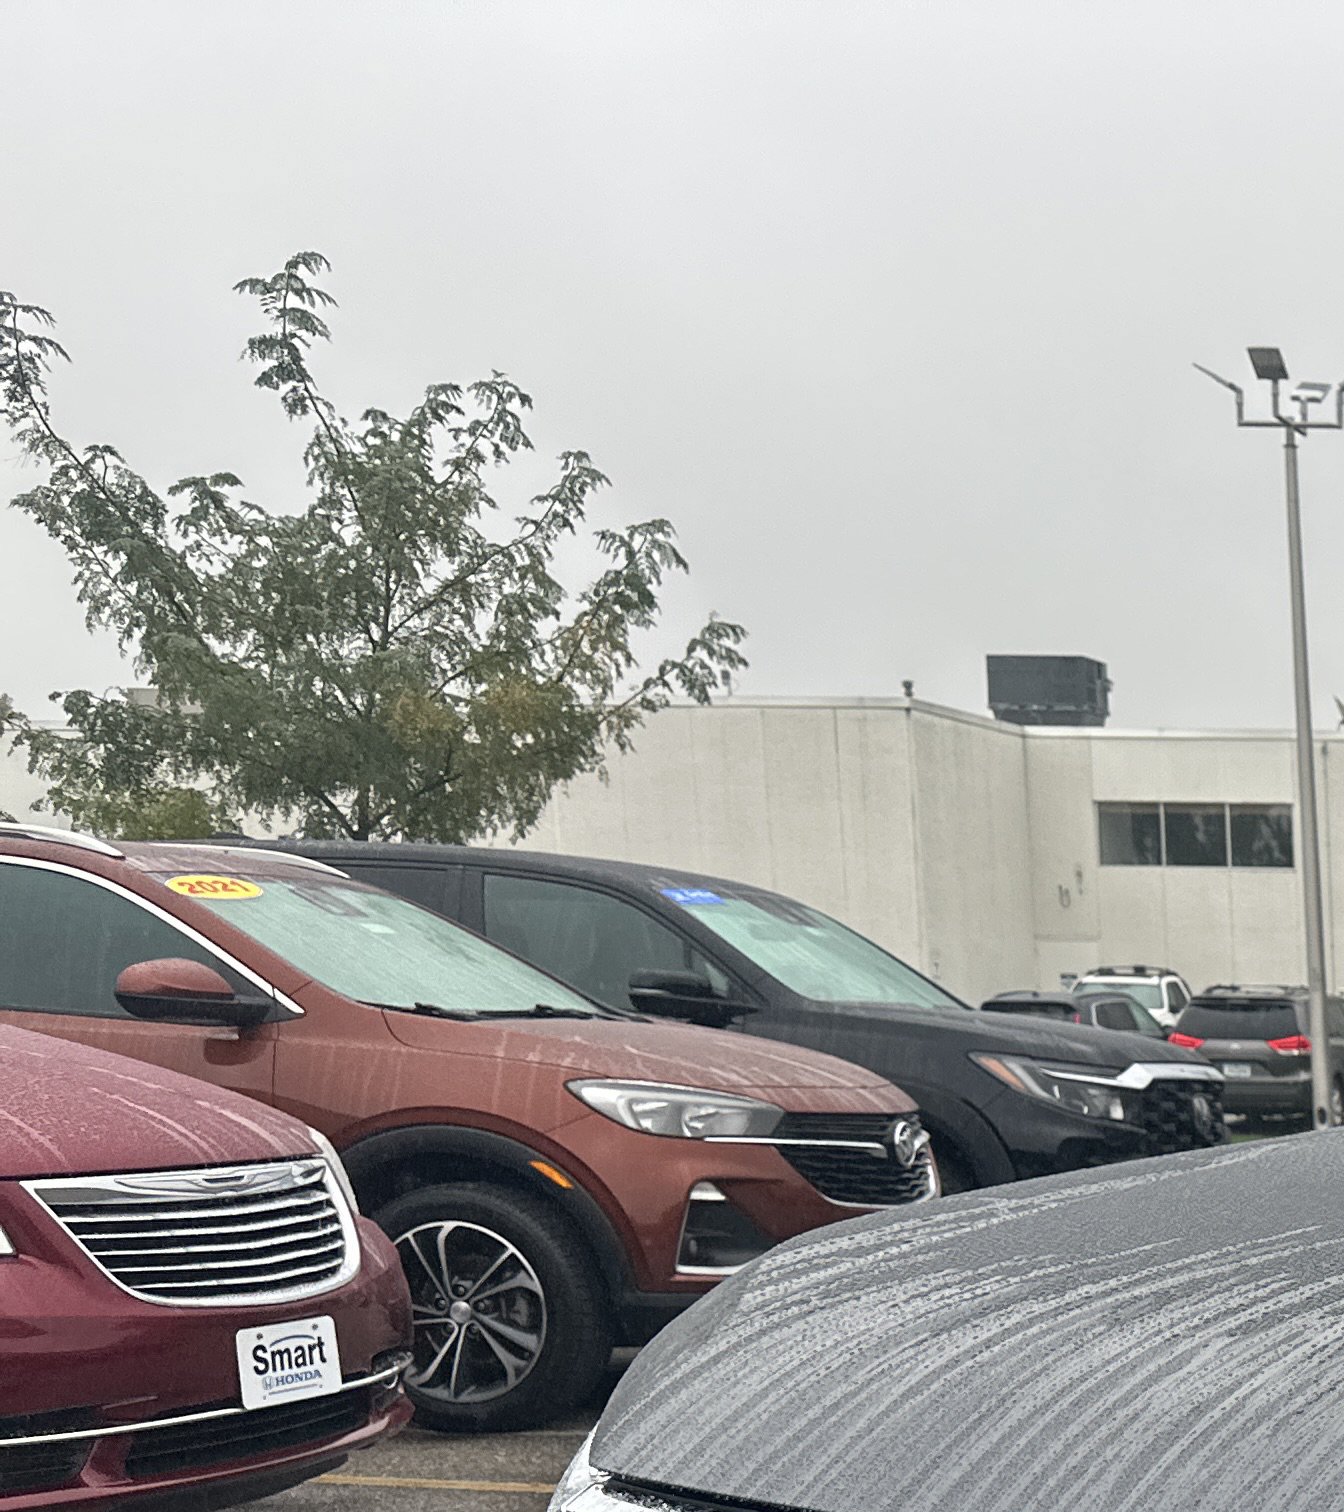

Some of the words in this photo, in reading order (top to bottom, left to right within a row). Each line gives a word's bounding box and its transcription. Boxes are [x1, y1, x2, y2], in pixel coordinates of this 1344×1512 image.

[177, 880, 251, 894] 2021
[252, 1336, 327, 1376] Smart
[275, 1369, 322, 1387] HONDA
